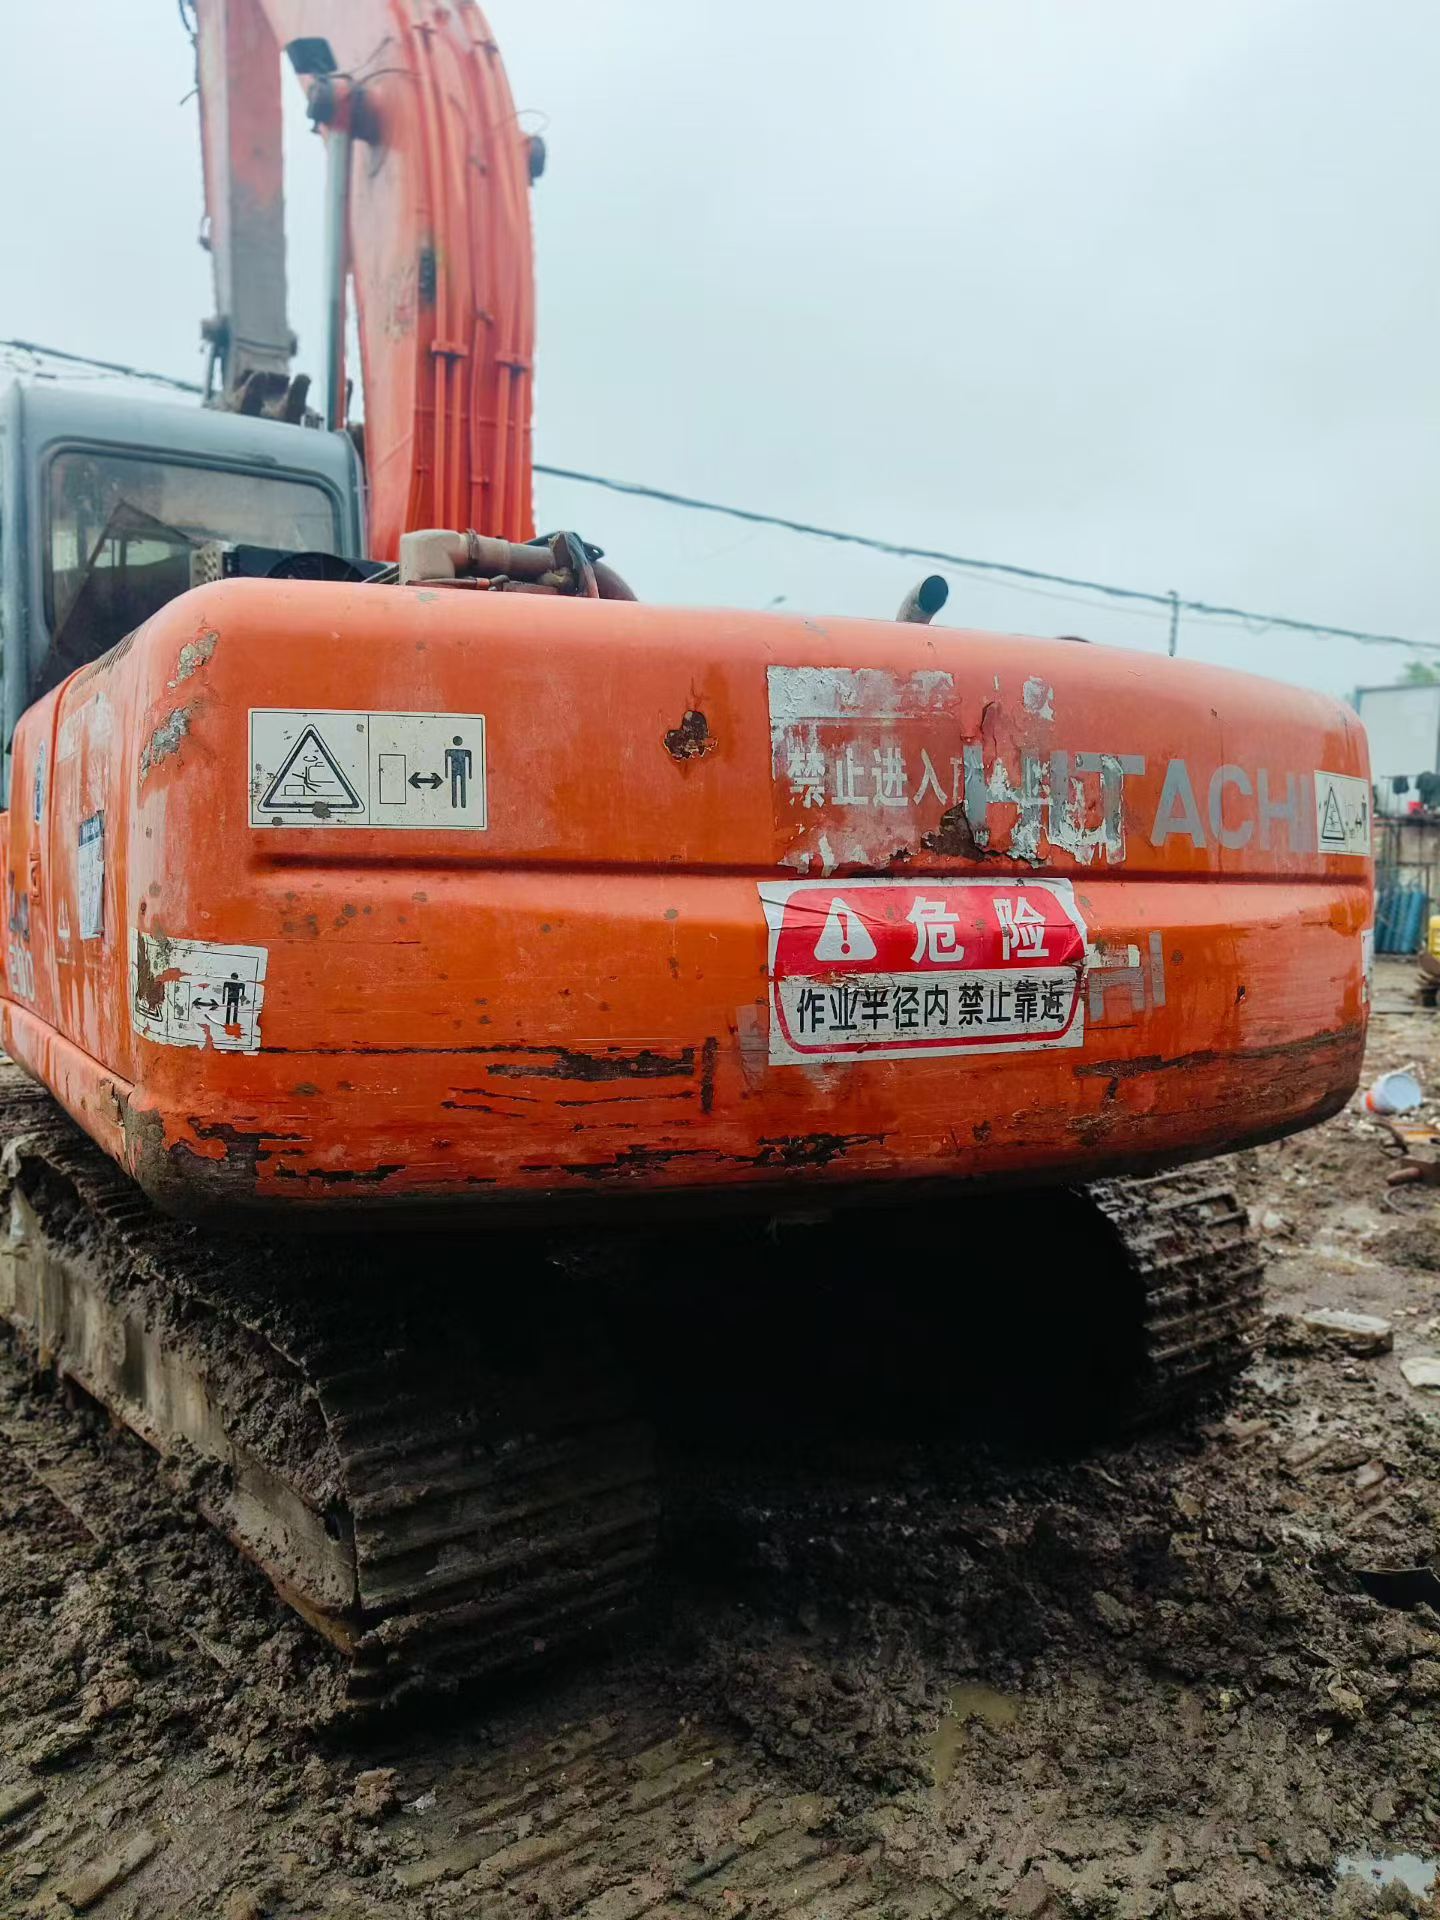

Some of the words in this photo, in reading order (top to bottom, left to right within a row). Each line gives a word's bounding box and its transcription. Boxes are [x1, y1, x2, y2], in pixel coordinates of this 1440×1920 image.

[787, 748, 963, 809] 禁止进入
[963, 745, 1315, 858] HITACHI
[905, 895, 1051, 964] 危险
[796, 979, 1066, 1033] 作业半径内禁止靠近
